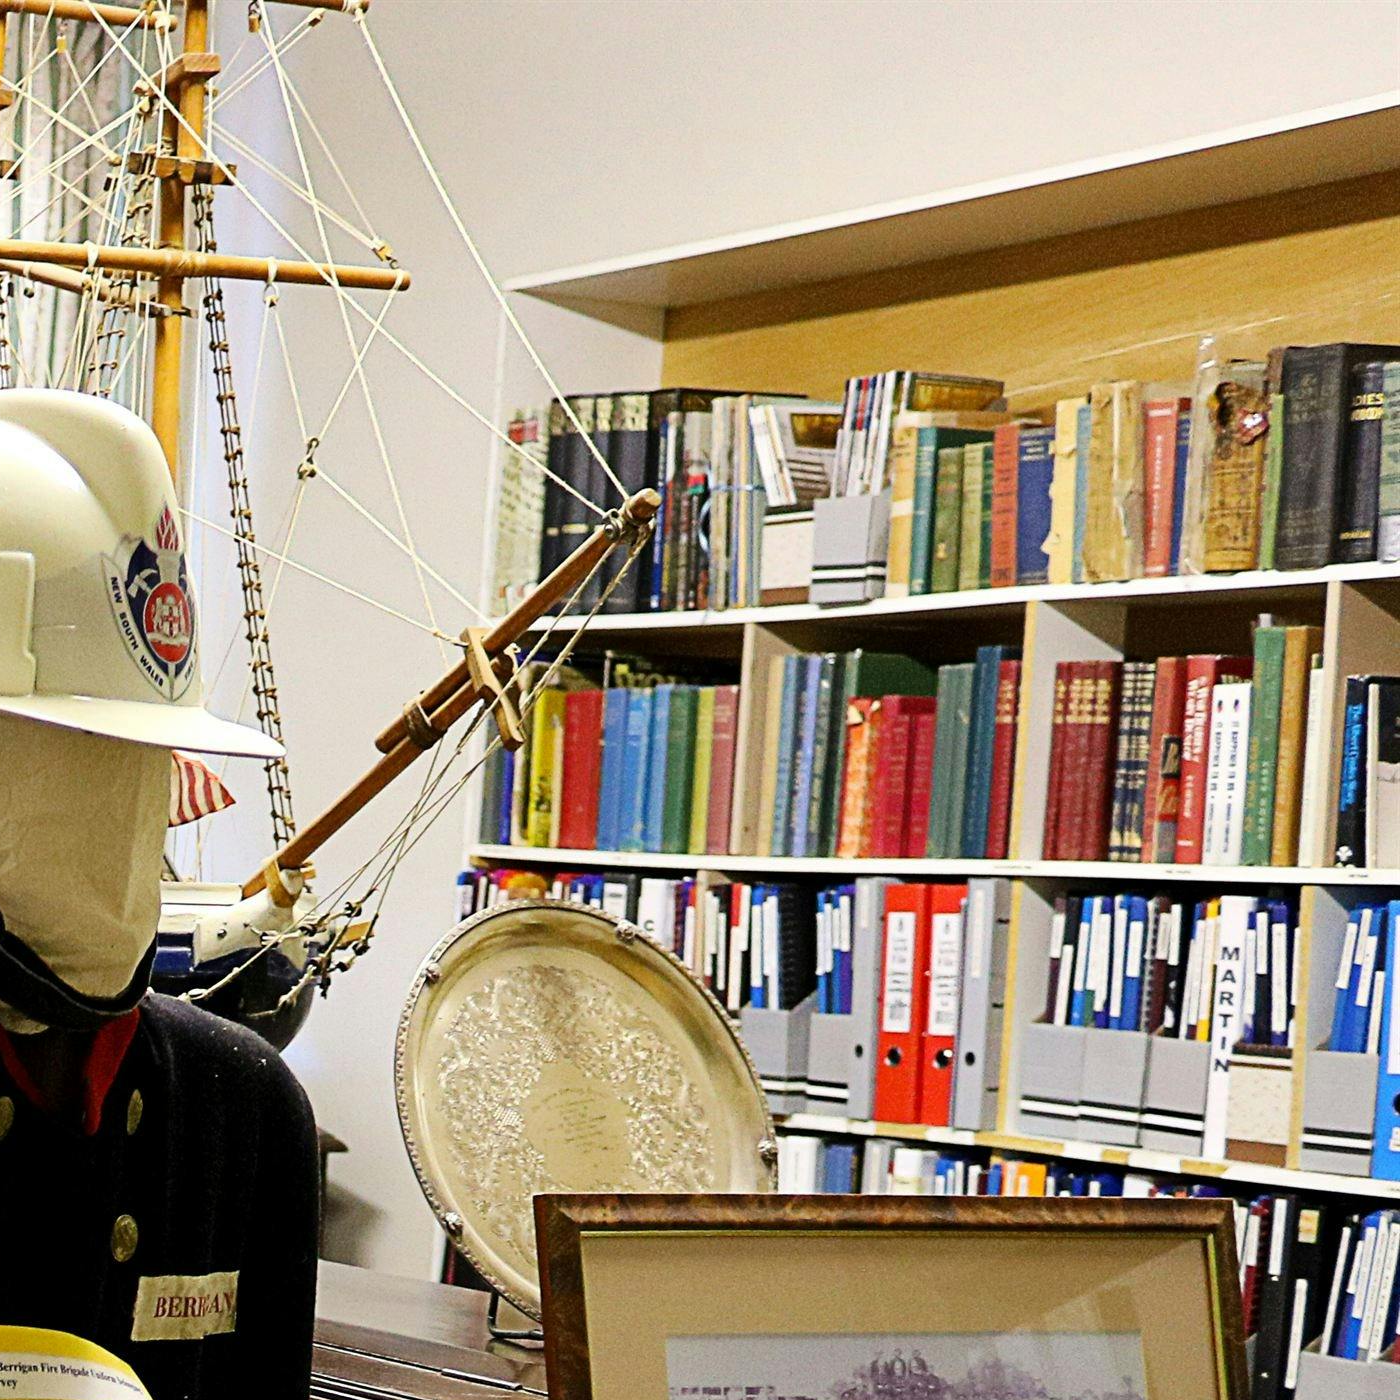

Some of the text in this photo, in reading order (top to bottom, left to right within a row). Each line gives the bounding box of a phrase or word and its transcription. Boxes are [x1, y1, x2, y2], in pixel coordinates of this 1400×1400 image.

[111, 577, 164, 687] NEW SOUTH WALES
[1214, 946, 1241, 1073] MARTIN
[41, 1363, 58, 1375] Fire
[60, 1365, 90, 1379] Brigade
